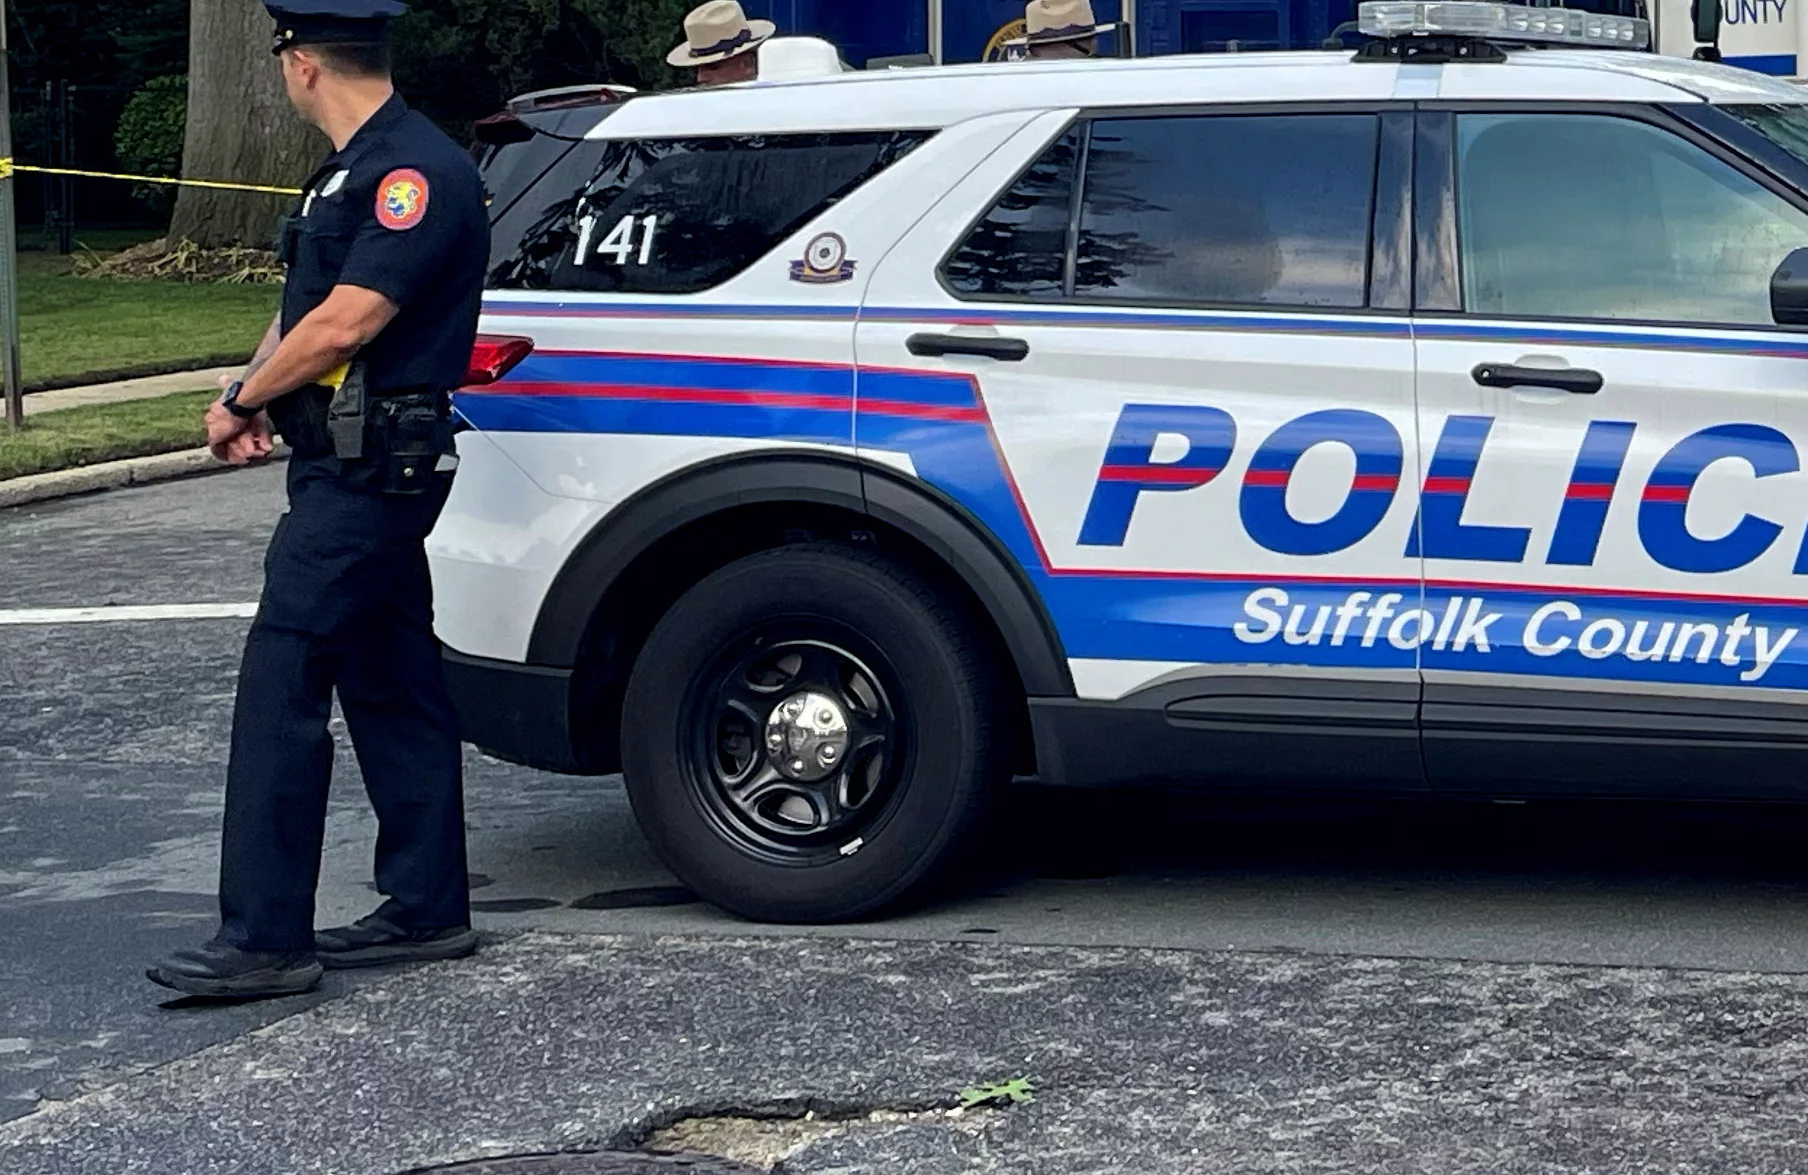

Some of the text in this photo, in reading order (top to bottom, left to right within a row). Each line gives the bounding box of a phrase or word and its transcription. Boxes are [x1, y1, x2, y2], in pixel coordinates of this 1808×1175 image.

[572, 214, 657, 266] 141
[1234, 586, 1800, 682] Suffolk County
